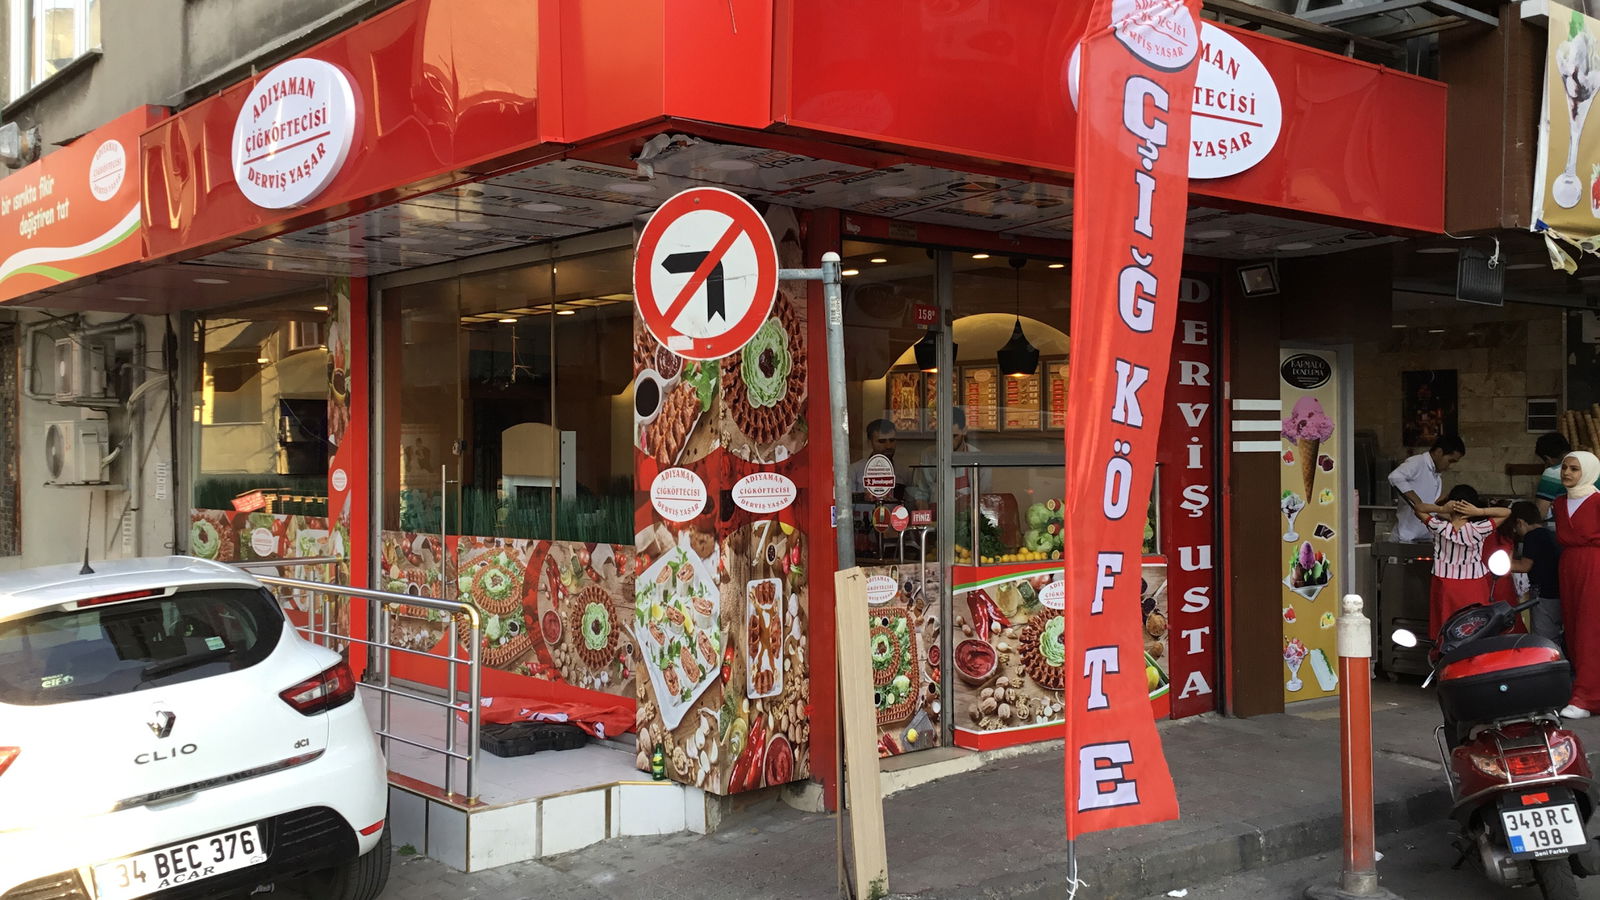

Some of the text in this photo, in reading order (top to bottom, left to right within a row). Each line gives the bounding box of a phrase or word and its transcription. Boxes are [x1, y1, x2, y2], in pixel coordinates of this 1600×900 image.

[253, 76, 315, 123] ADIYAMAN
[1194, 87, 1255, 116] TECİSİ
[245, 102, 327, 158] ÇİĞKÖFTECİSİ
[1192, 131, 1253, 159] YAŞAR
[247, 142, 327, 192] DERVİŞ YAŞAR
[57, 198, 70, 220] tat
[661, 469, 695, 483] ADIYAMAN
[745, 474, 784, 485] ADIYAMAN
[134, 743, 198, 765] CLIO
[1529, 828, 1563, 848] 198
[115, 829, 255, 888] 34 BEC 376
[157, 865, 216, 889] ACAR
